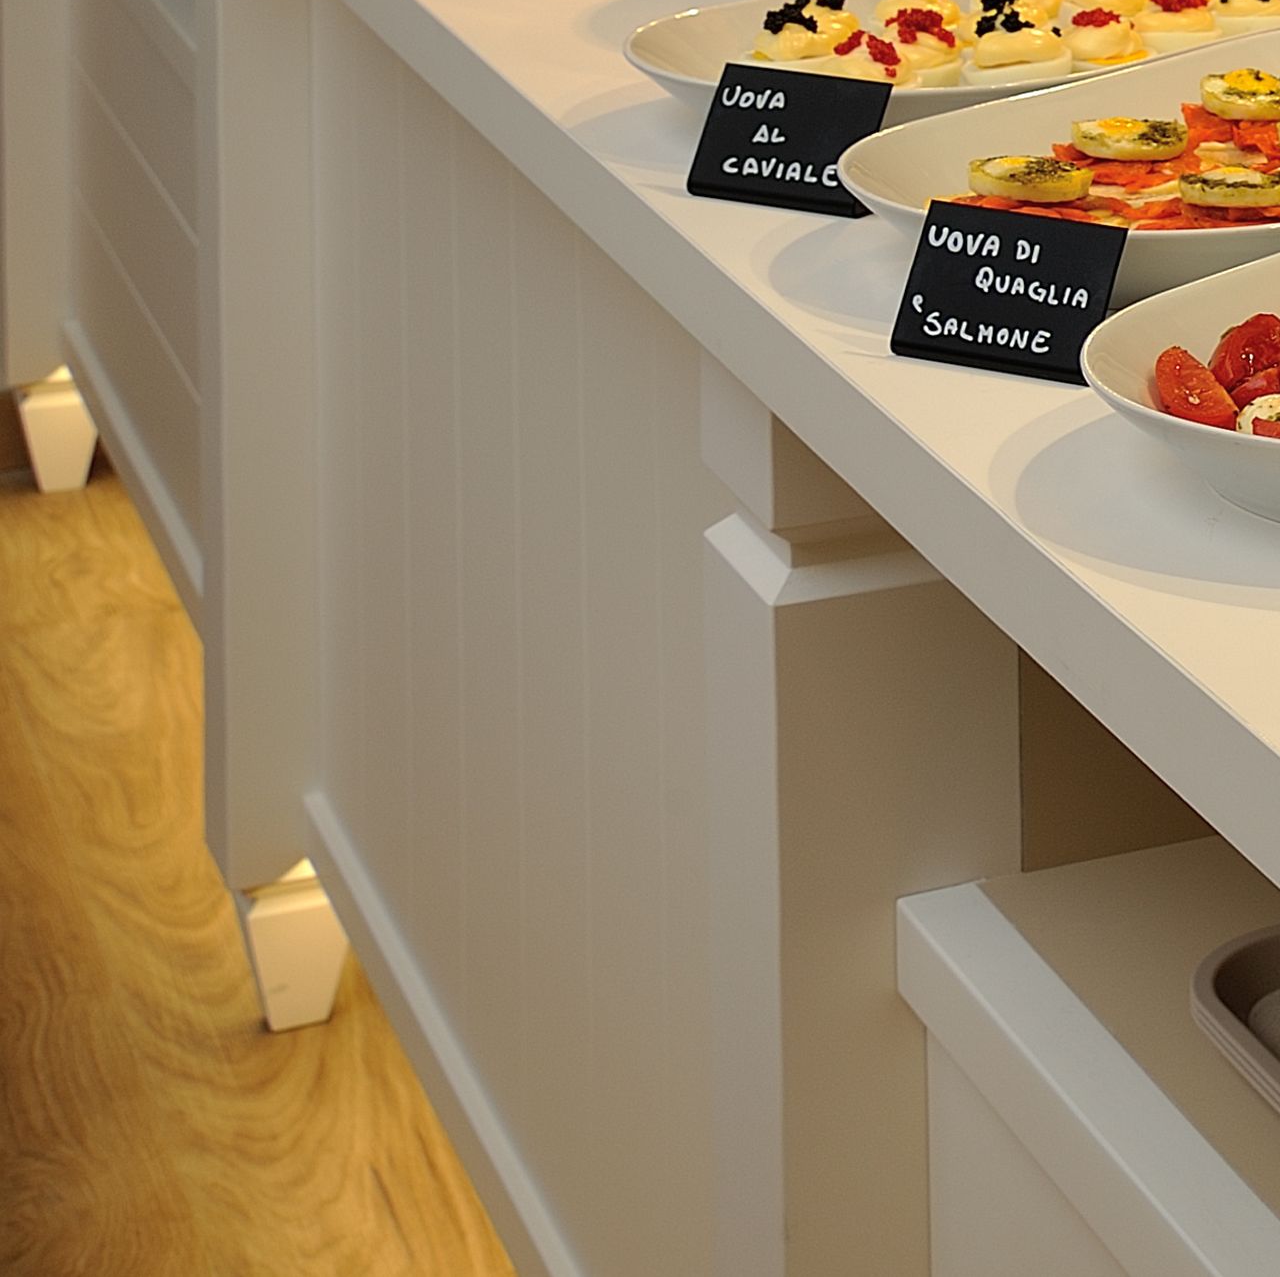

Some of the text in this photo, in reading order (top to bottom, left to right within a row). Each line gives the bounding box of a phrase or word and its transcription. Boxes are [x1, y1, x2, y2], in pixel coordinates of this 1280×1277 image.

[722, 84, 786, 110] UOVA
[751, 123, 787, 144] AL
[722, 156, 839, 188] CAVIALE
[927, 223, 1042, 264] UOVA DI
[974, 266, 1090, 310] QUAGLIA
[922, 310, 1052, 354] SALMONE
